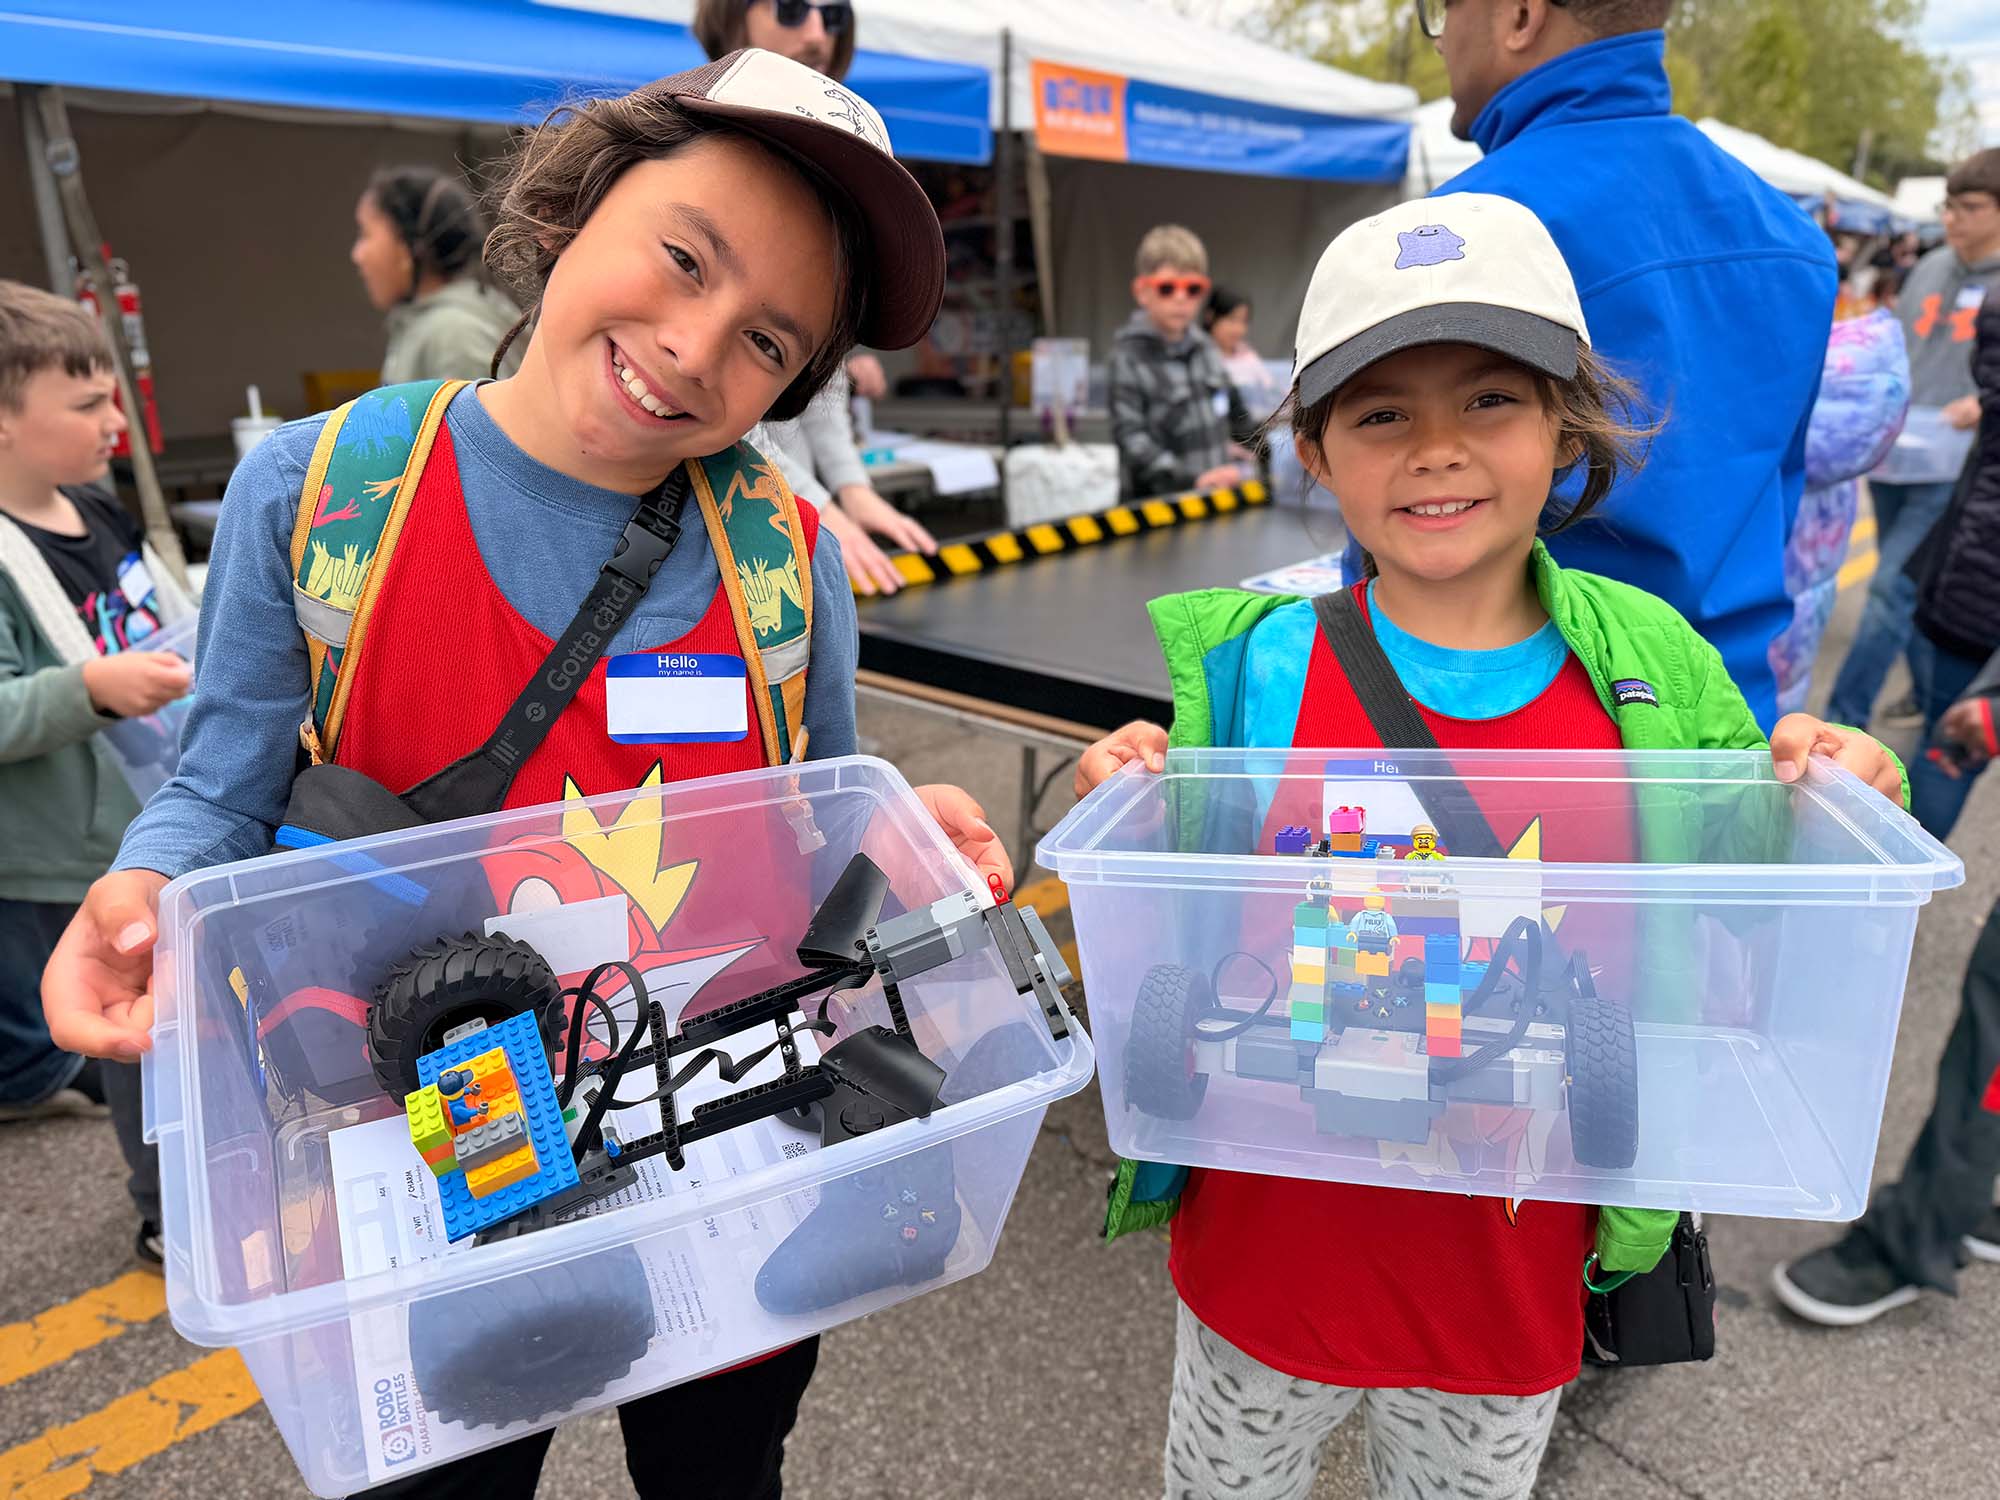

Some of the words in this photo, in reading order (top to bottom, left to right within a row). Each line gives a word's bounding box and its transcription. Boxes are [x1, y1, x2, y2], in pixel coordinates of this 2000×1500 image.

[547, 630, 601, 691] Gotta
[595, 577, 636, 632] catch
[657, 655, 698, 668] Hello
[1373, 760, 1399, 774] Hel
[405, 1170, 416, 1193] CHARM
[413, 1215, 421, 1229] WIT
[374, 1378, 397, 1431] ROBO
[393, 1372, 411, 1424] BATTLES
